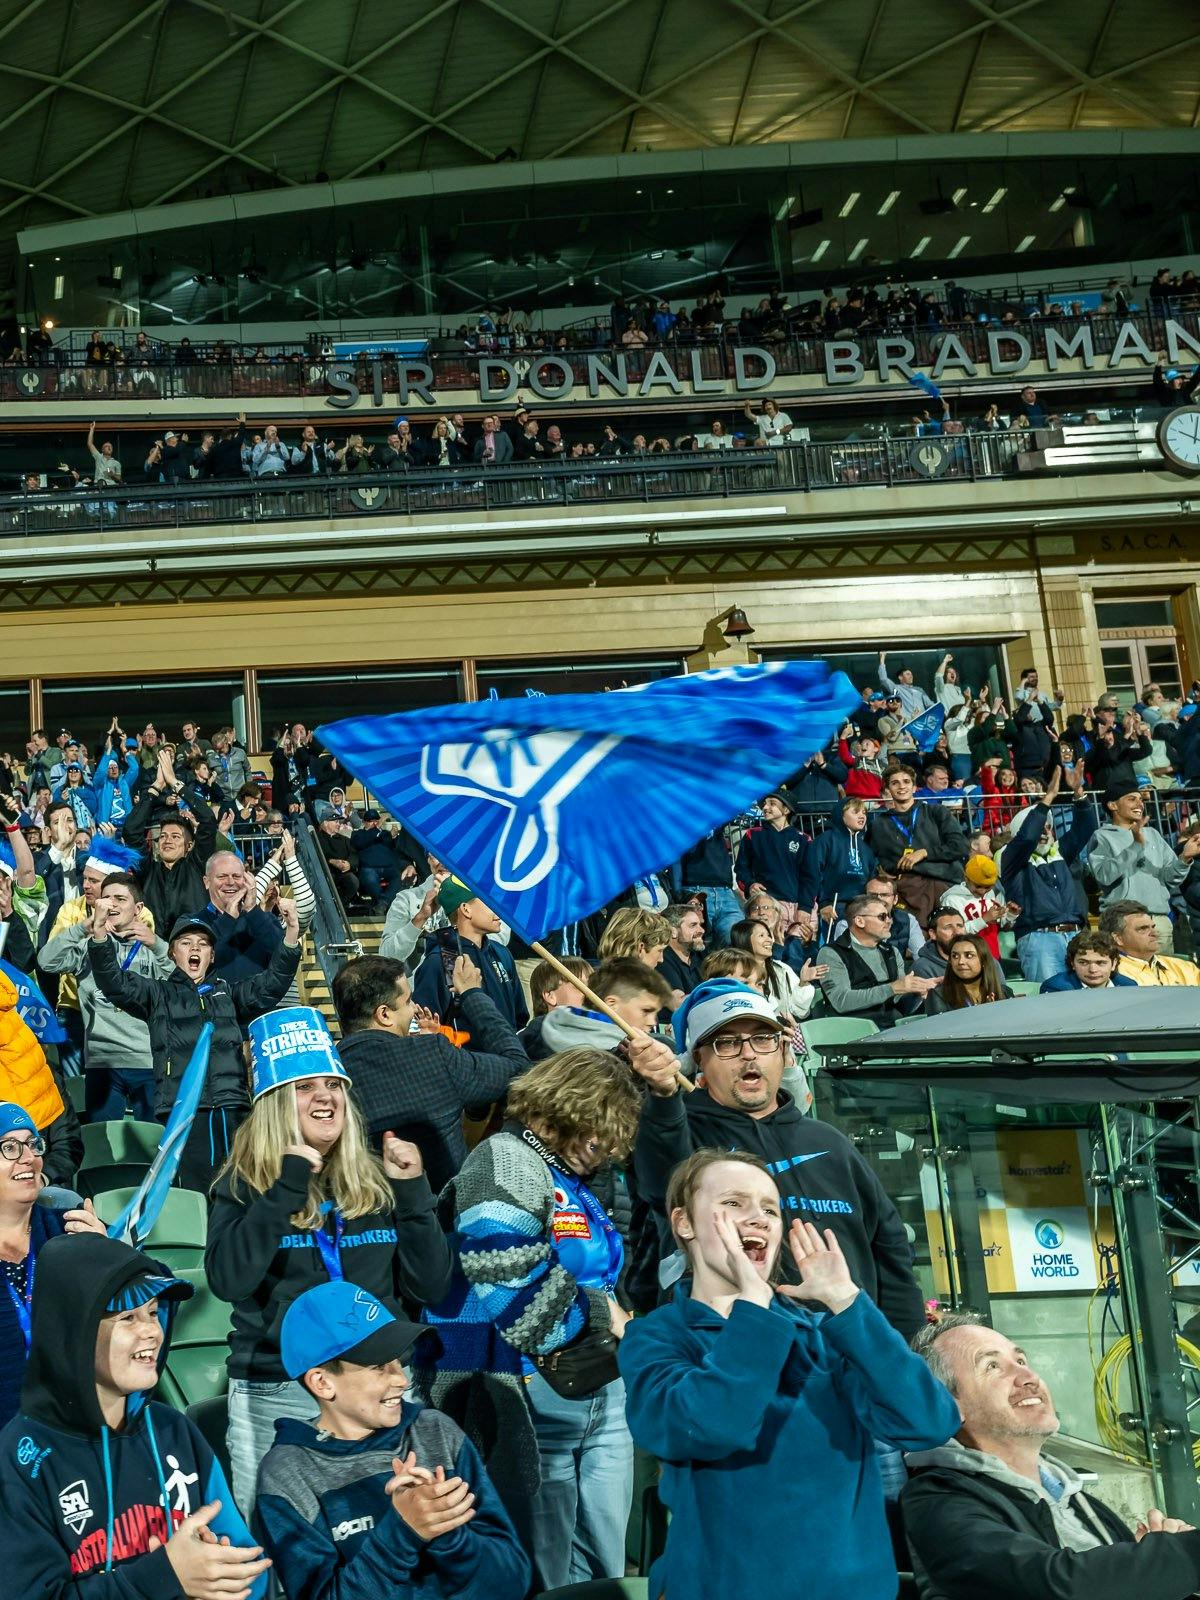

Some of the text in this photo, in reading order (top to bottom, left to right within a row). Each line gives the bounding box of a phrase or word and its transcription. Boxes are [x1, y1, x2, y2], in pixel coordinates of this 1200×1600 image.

[326, 314, 1200, 408] SIR DONALD BRADMAN
[279, 1020, 310, 1033] THESE
[1008, 1163, 1066, 1177] homestar
[553, 1222, 588, 1232] choice
[340, 1228, 398, 1248] STRIKERS
[1033, 1253, 1074, 1266] HOME
[1031, 1265, 1079, 1278] WORLD
[58, 1491, 89, 1516] SA
